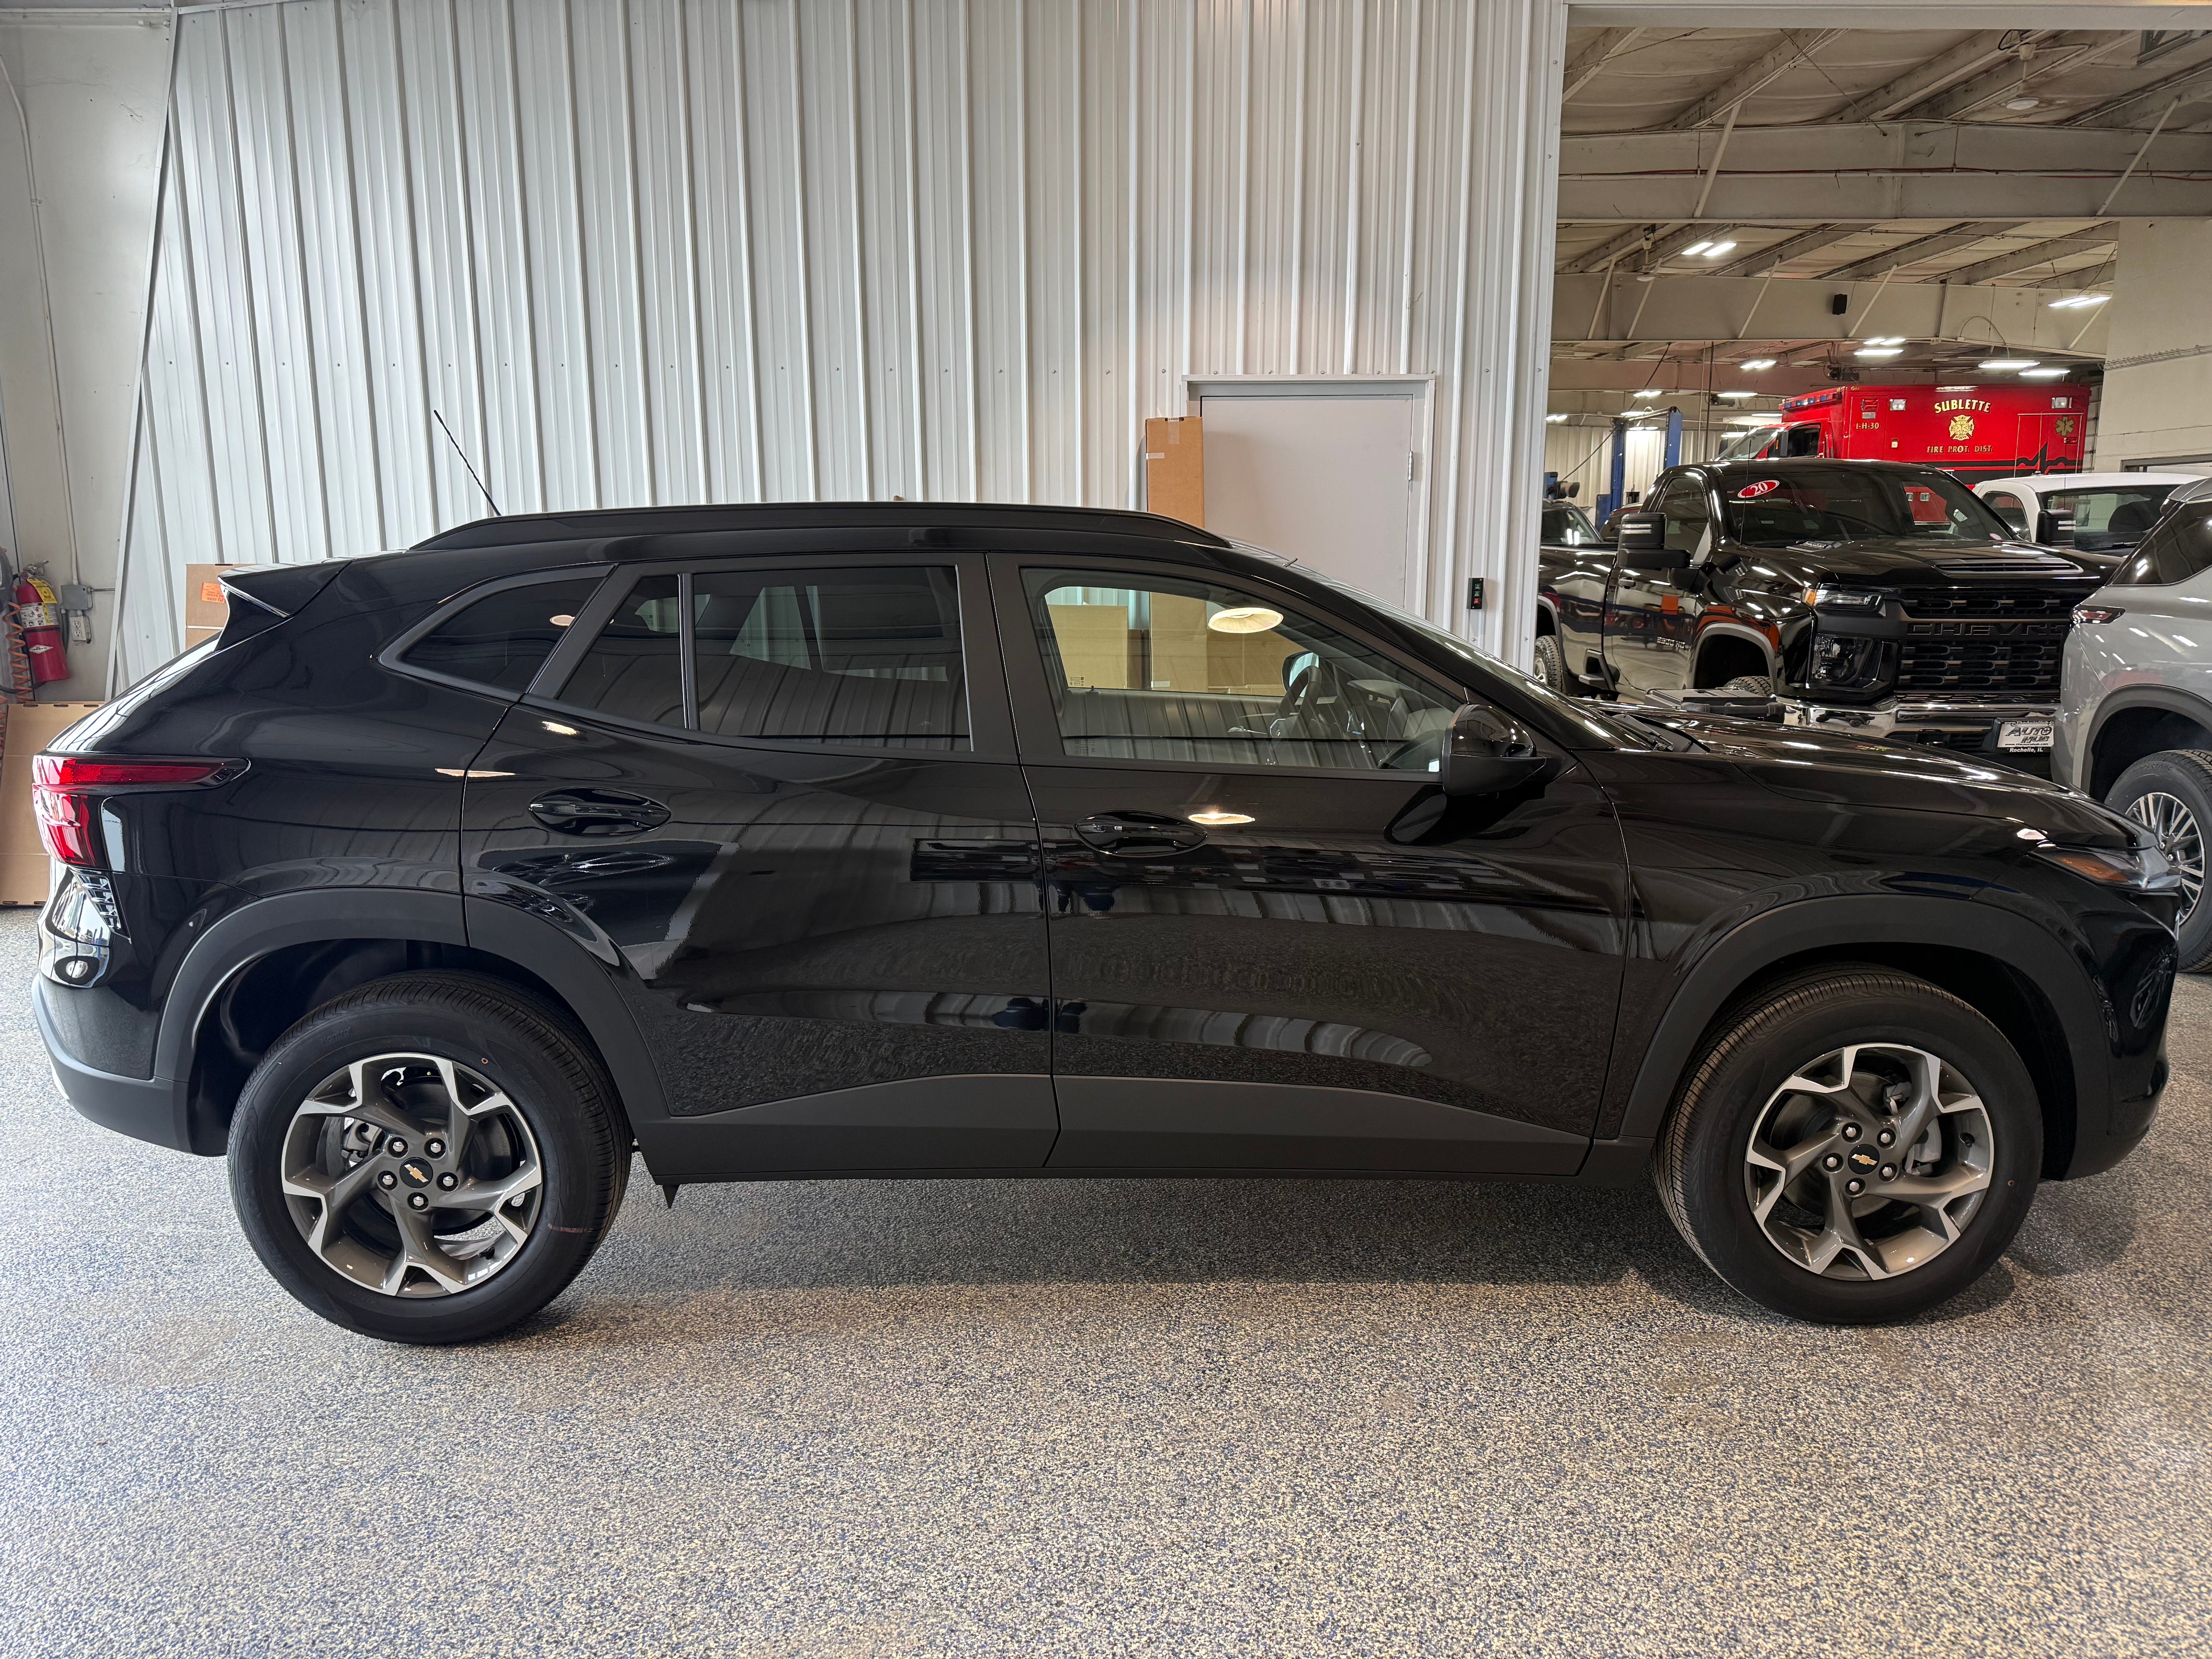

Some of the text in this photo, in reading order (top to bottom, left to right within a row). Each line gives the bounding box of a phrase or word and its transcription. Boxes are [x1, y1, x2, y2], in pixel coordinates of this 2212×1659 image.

[1934, 399, 1991, 414] SUBLETTE
[1948, 445, 1970, 453] PROT.
[1974, 445, 1993, 453] DIST.
[1750, 482, 1768, 495] 20
[2005, 726, 2052, 736] AUTO
